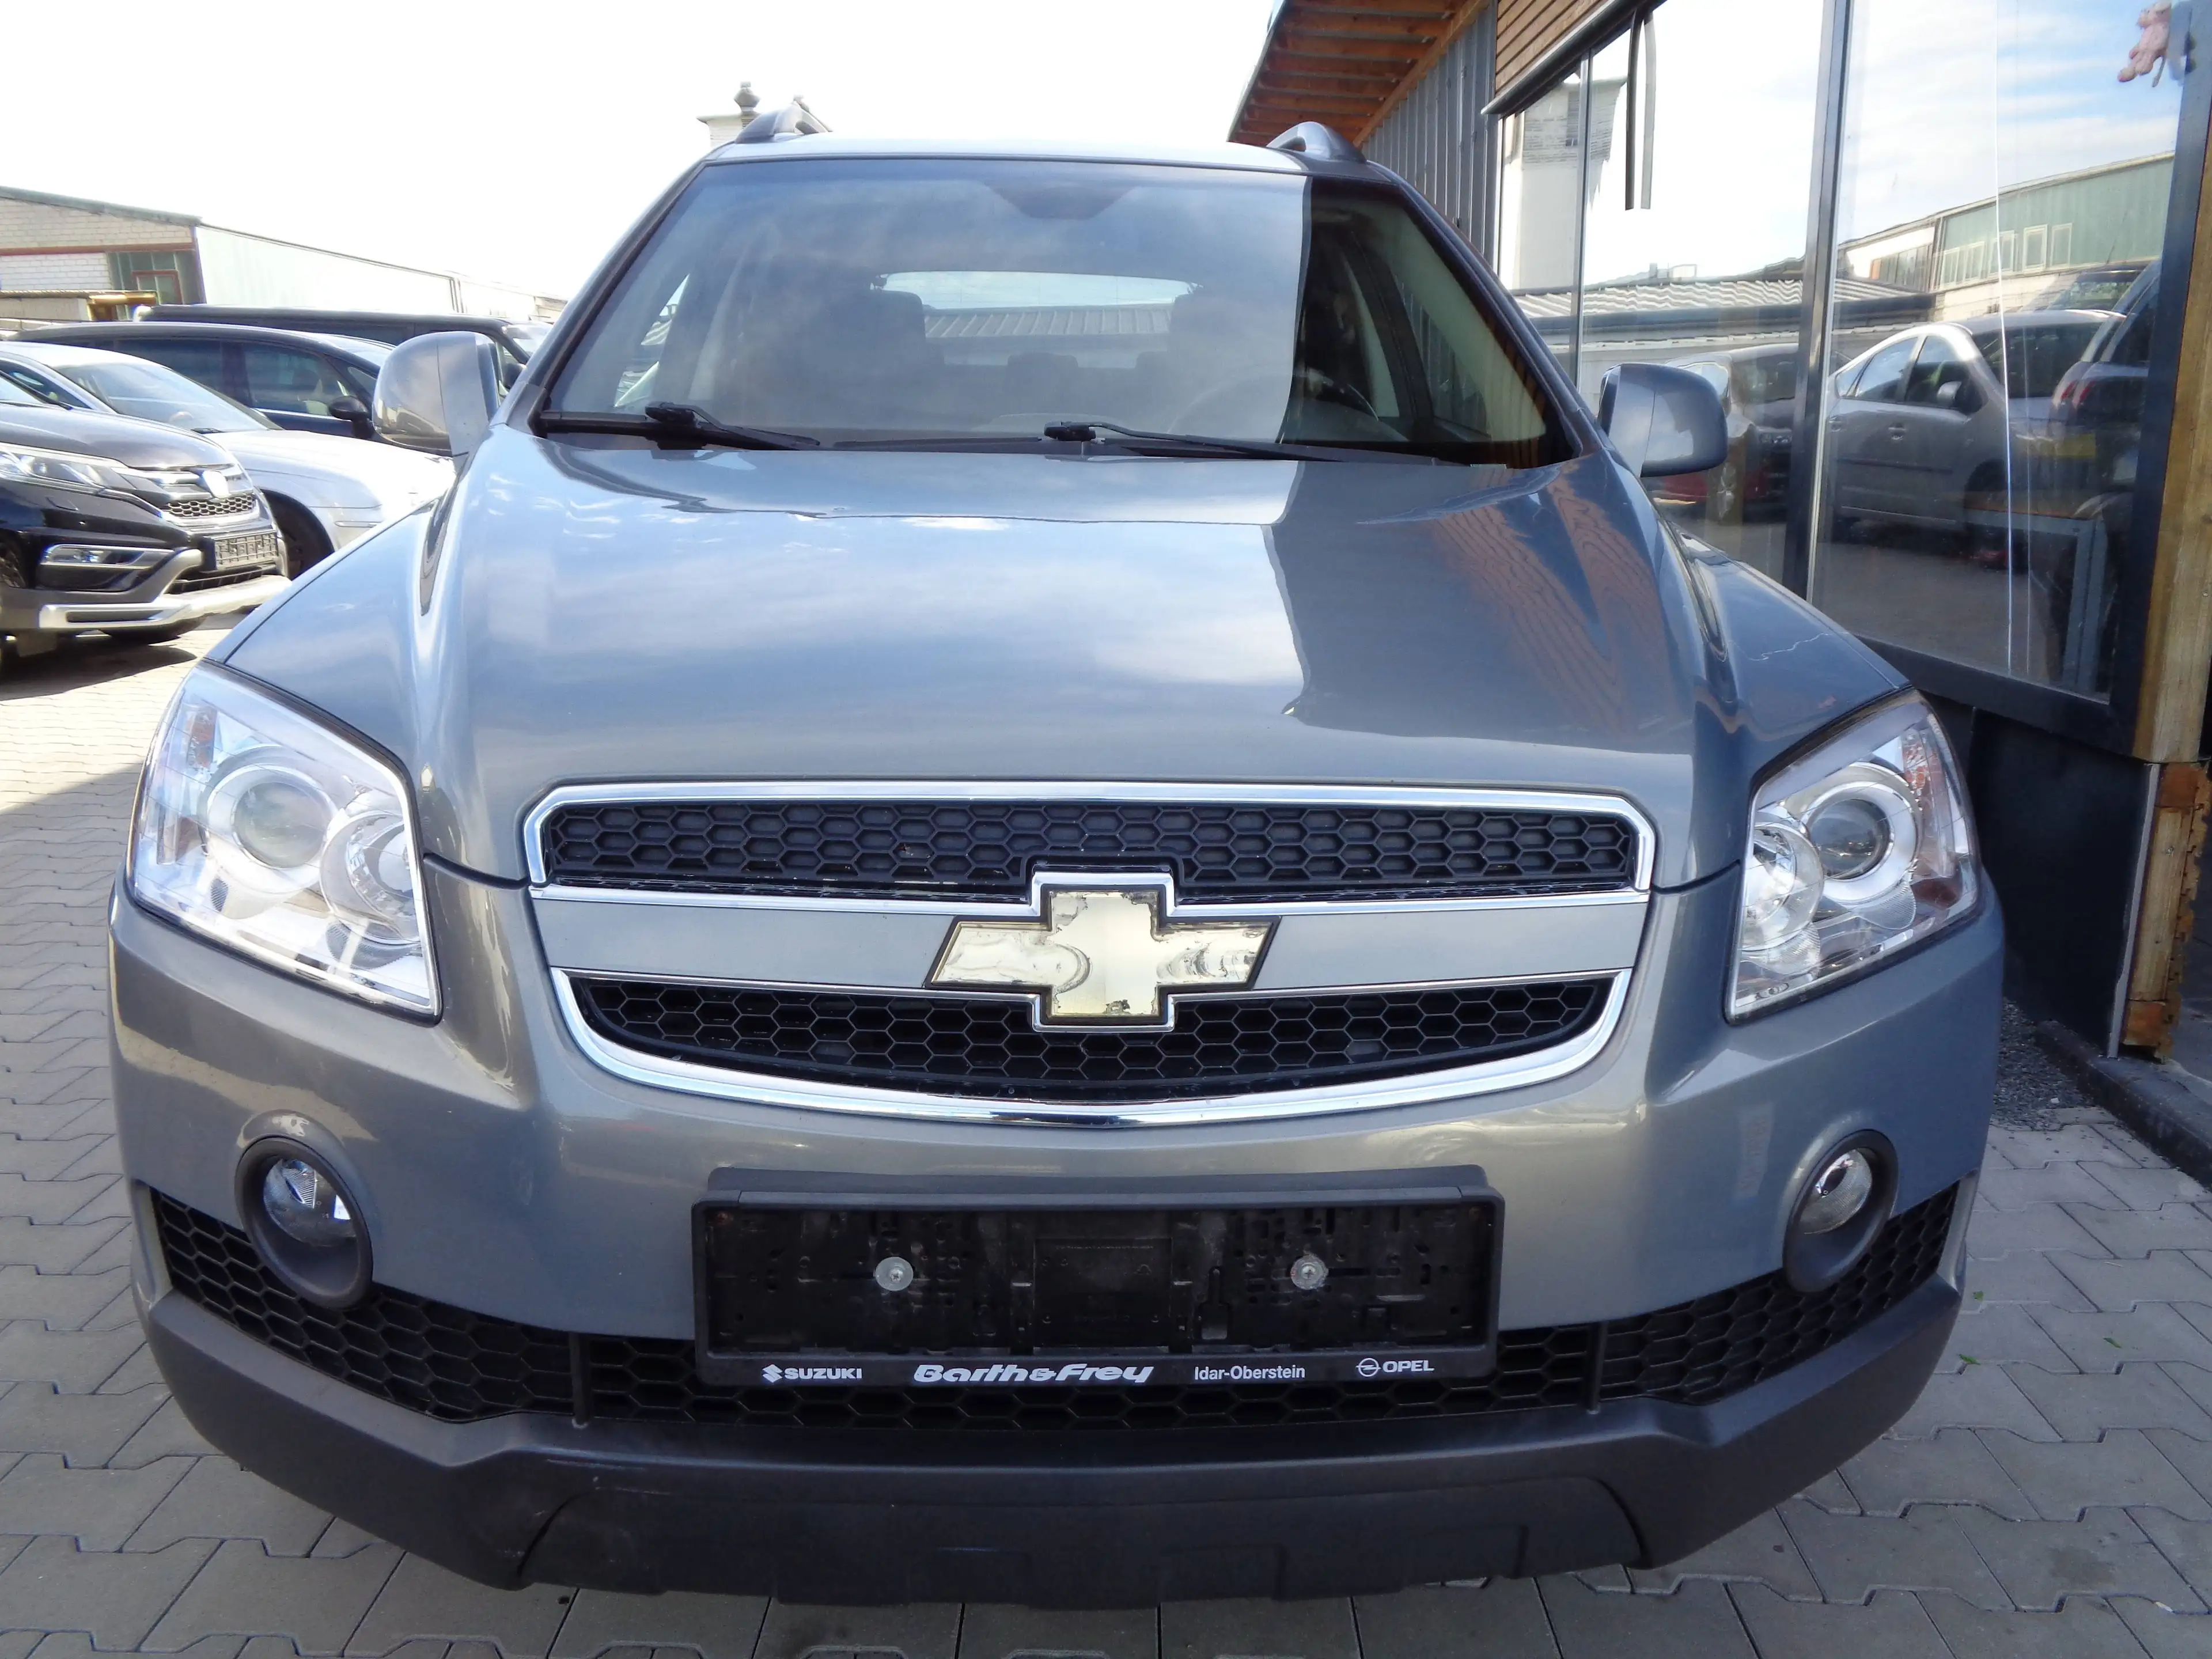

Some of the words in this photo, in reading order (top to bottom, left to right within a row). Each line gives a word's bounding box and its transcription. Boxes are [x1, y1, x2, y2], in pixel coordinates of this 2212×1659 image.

[914, 1363, 1154, 1382] Barth&Frey
[1194, 1365, 1305, 1380] Idar-Oberstein
[1382, 1360, 1435, 1373] OPEL
[784, 1368, 862, 1380] SUZUKI
